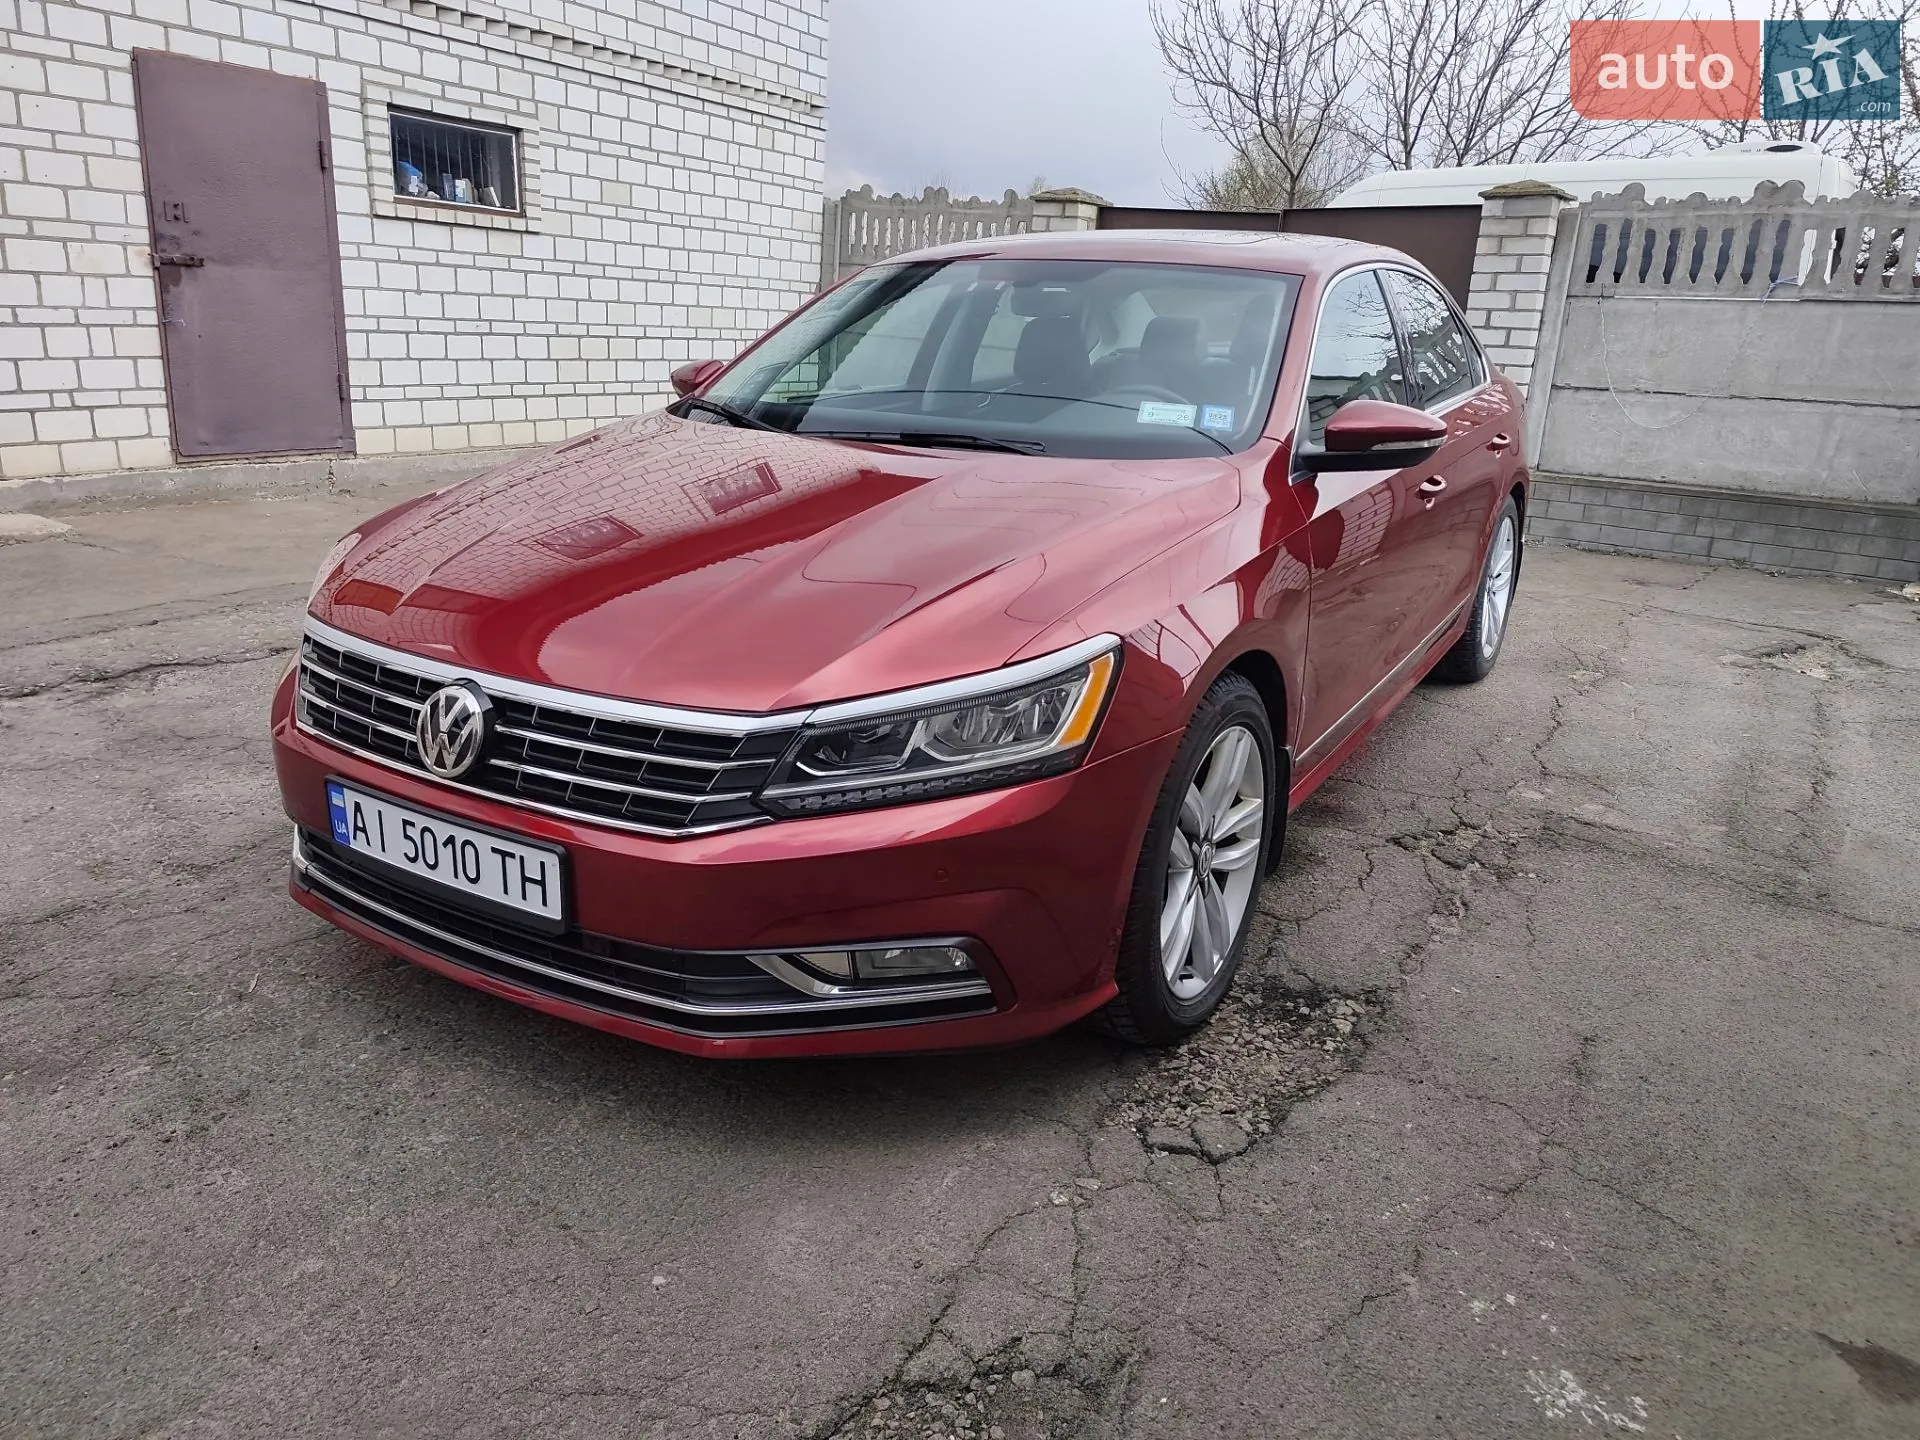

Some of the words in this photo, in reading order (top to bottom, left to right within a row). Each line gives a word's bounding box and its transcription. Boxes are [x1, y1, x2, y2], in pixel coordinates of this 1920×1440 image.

[335, 819, 348, 837] UA
[353, 800, 386, 853] AI
[401, 818, 481, 885] 5010
[490, 846, 548, 907] TH
